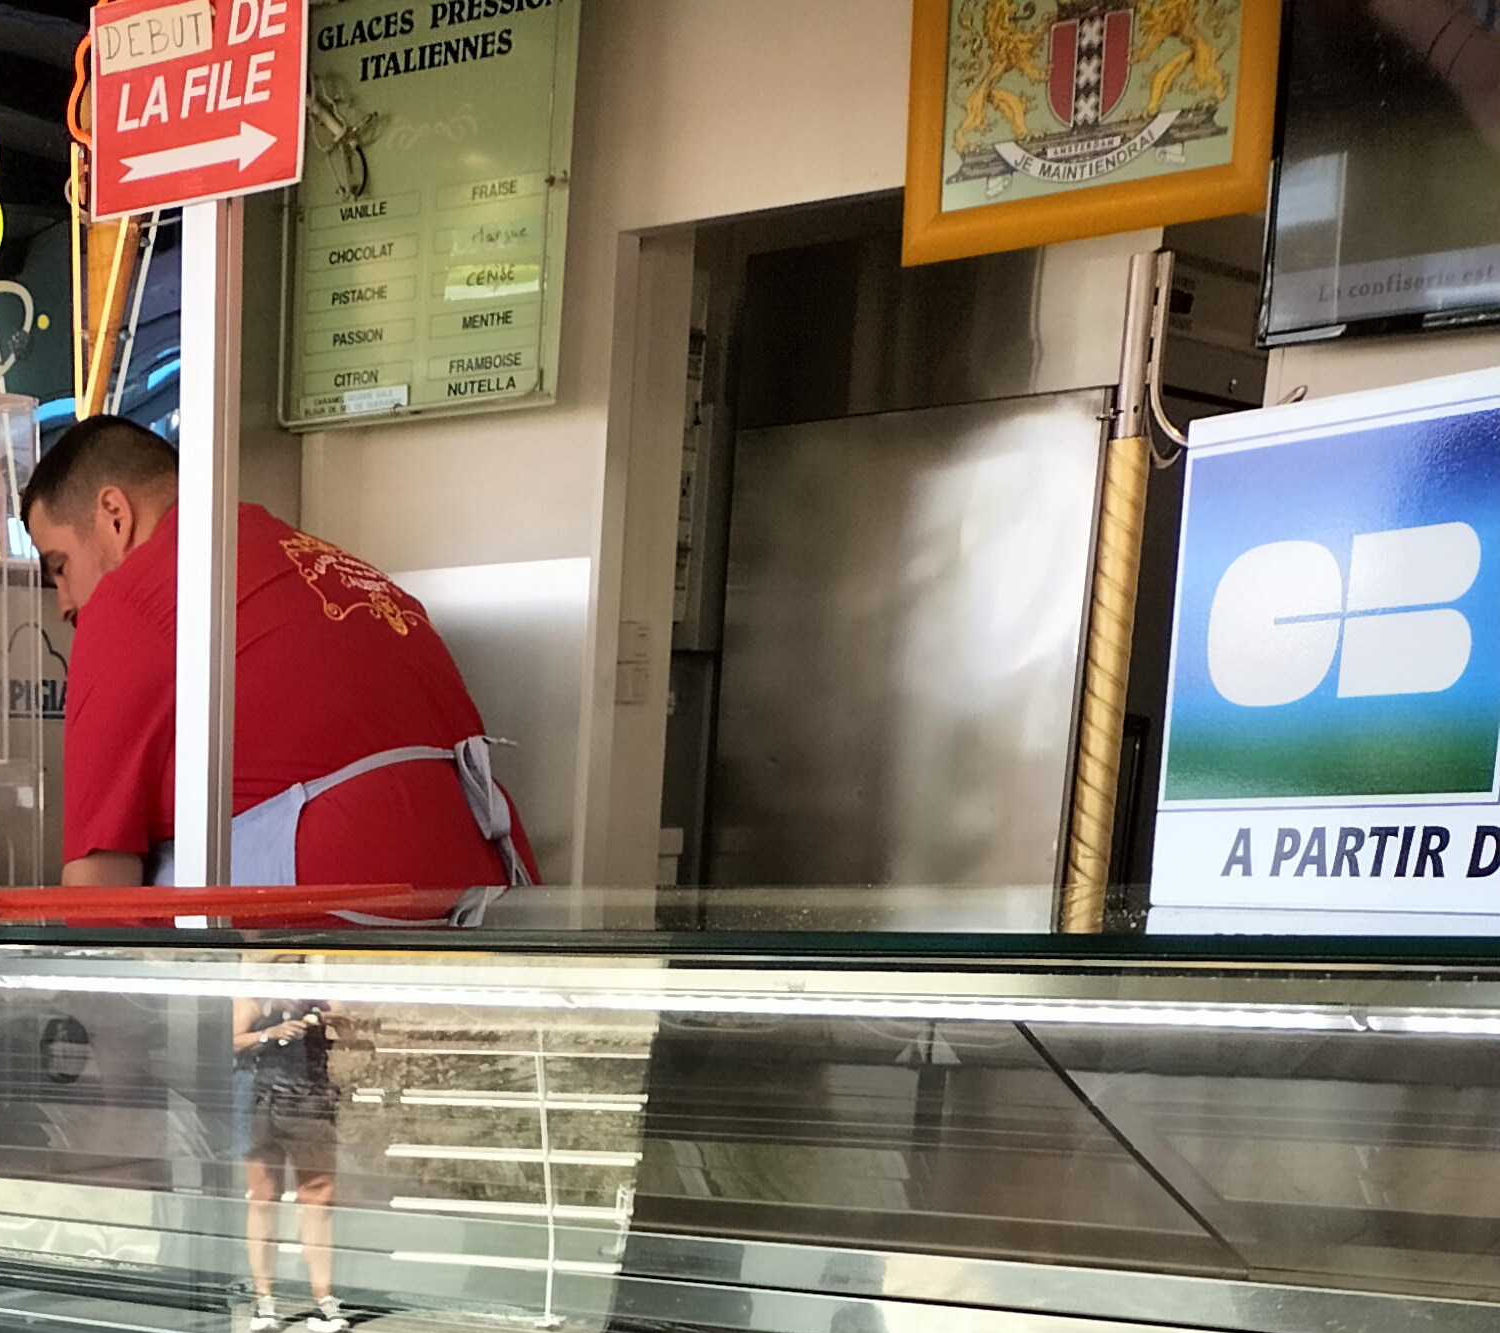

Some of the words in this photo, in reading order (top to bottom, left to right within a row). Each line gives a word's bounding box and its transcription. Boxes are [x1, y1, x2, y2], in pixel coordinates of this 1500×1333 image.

[104, 12, 204, 60] DEBUT
[227, 0, 288, 46] DE
[317, 9, 414, 51] GLACES
[360, 29, 513, 82] ITALIENNES
[116, 75, 169, 132] LA
[180, 51, 276, 120] FILE
[1015, 155, 1033, 172] JE
[1038, 130, 1156, 180] MAINTIENDRAI
[471, 180, 518, 200] FRAISE
[339, 201, 387, 221] VANILLE
[328, 243, 394, 265] CHOCOLAT
[331, 285, 388, 305] PISTACHE
[462, 310, 513, 330] MENTHE
[332, 328, 383, 347] PASSION
[448, 352, 522, 374] FRAMBOISE
[334, 370, 378, 387] CITRON
[447, 376, 516, 397] NUTELLA
[1220, 827, 1253, 877] A
[1269, 825, 1451, 878] PARTIR
